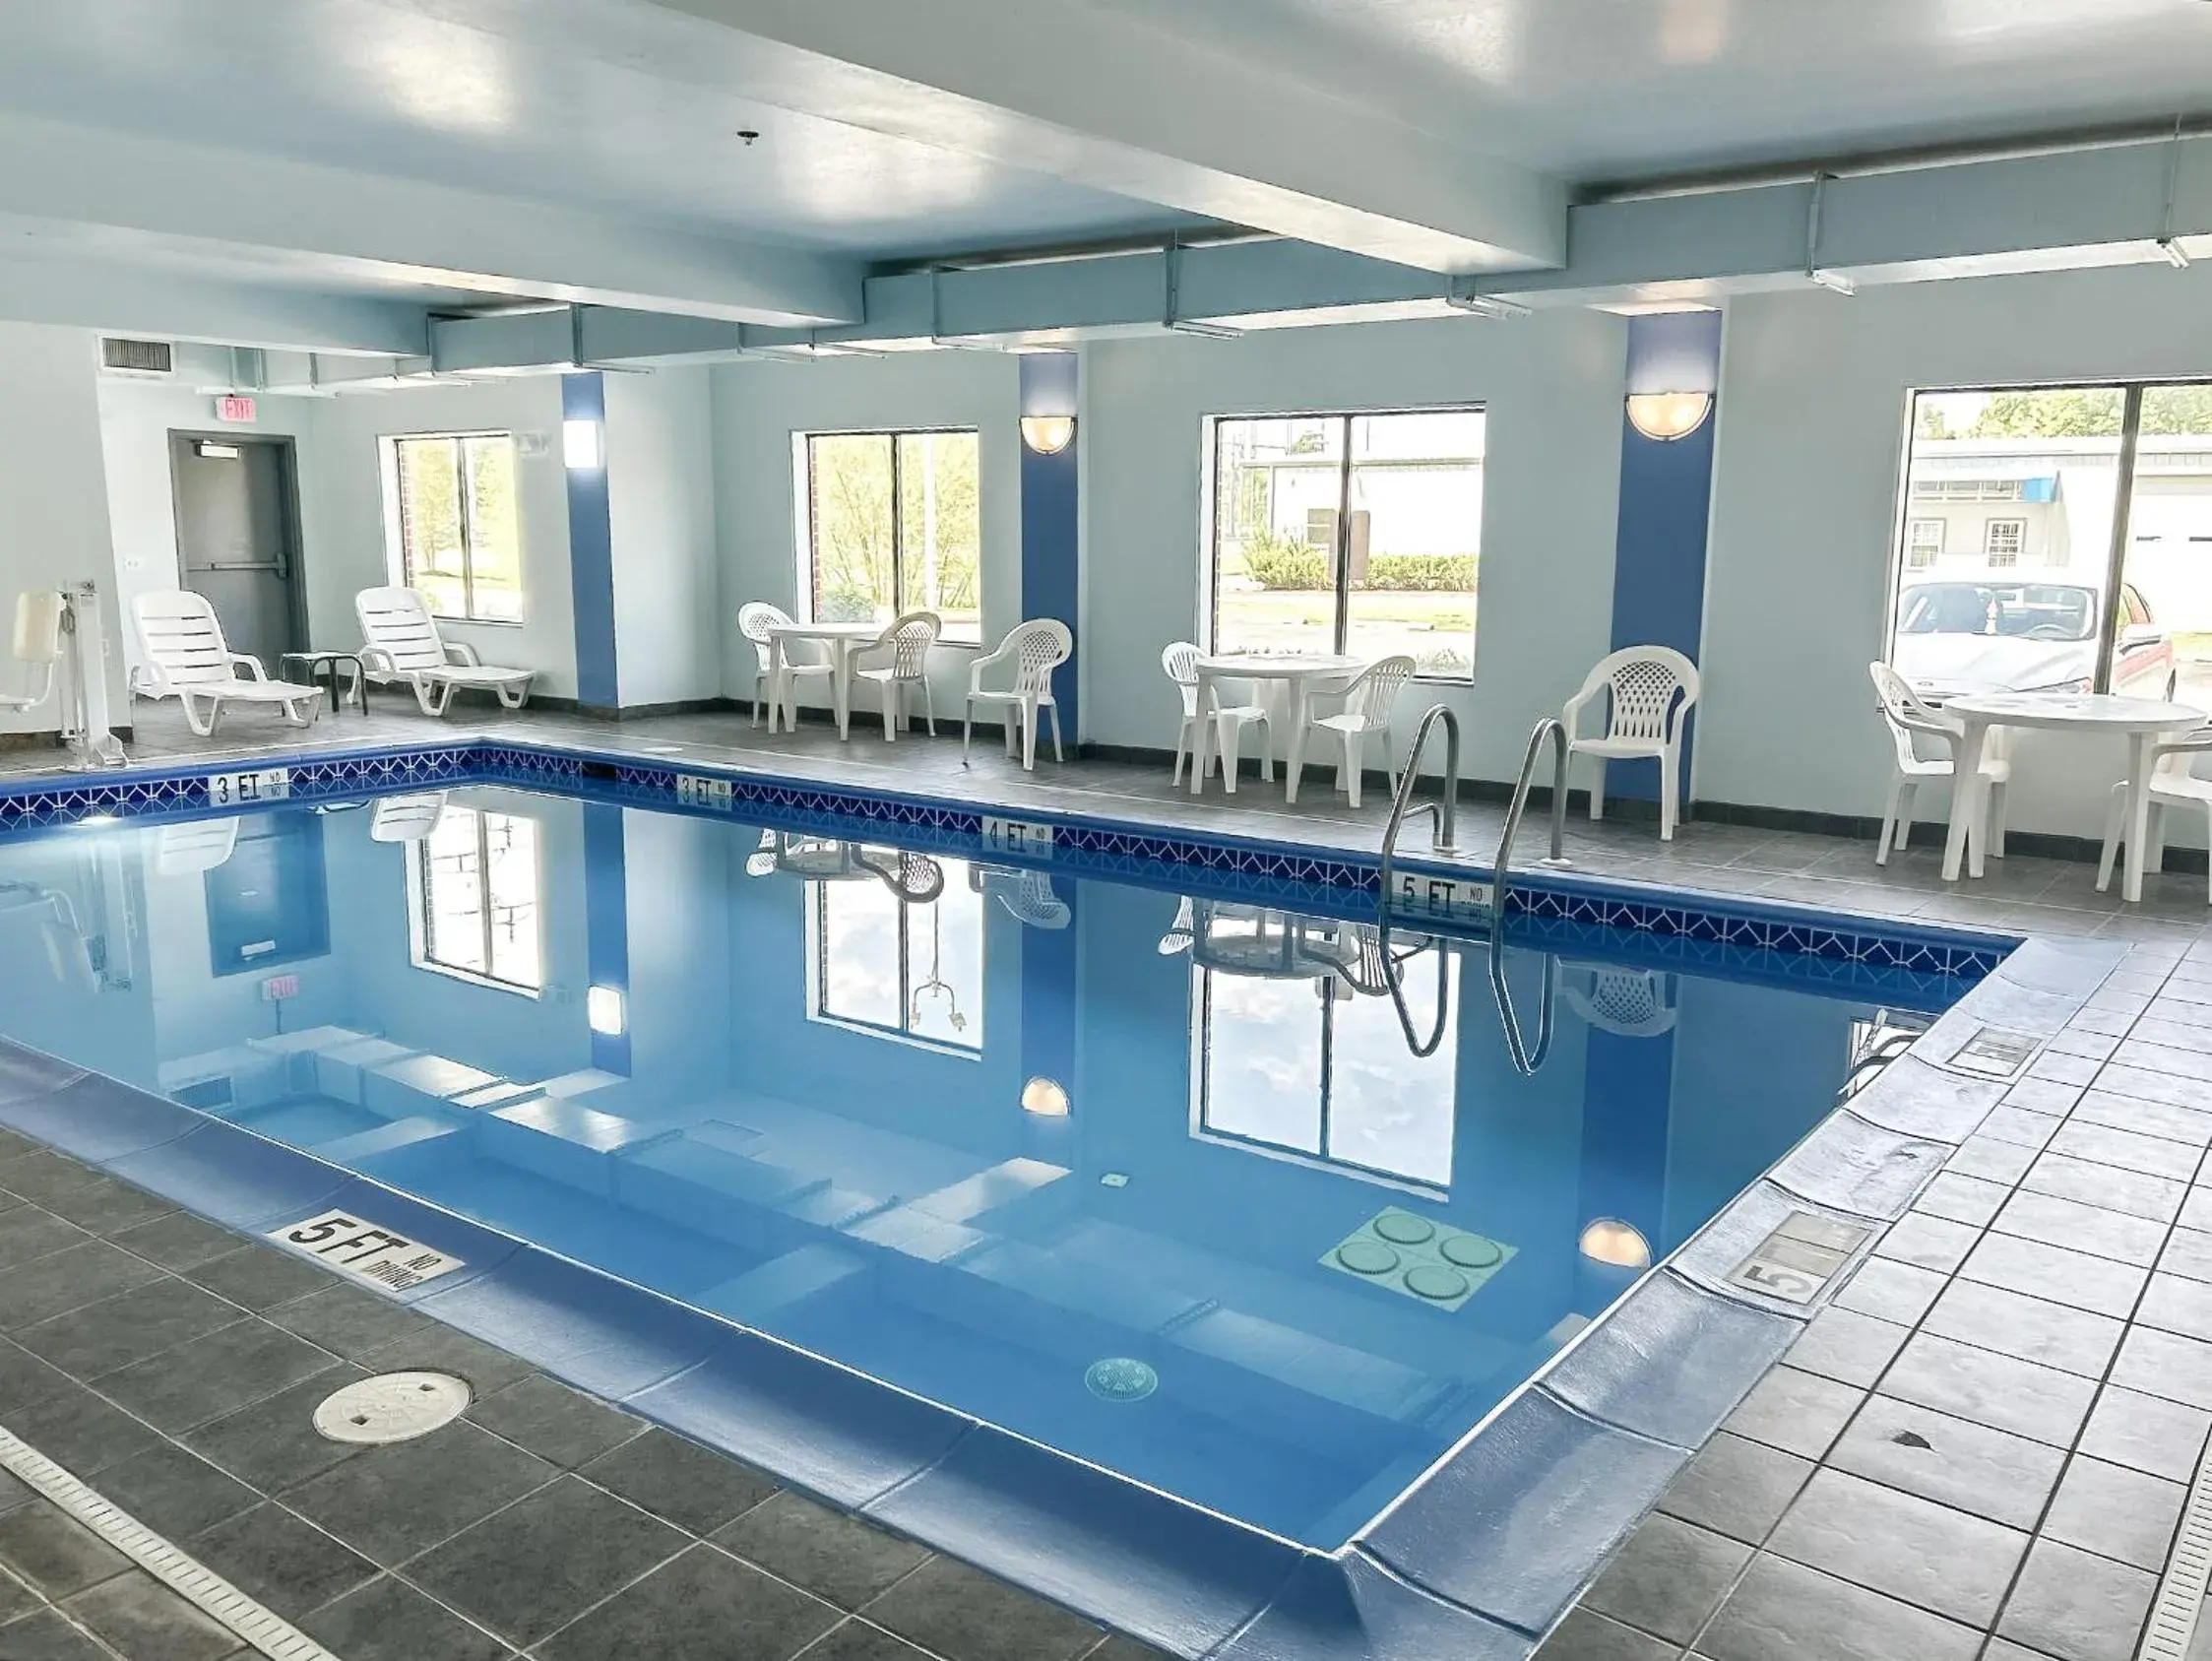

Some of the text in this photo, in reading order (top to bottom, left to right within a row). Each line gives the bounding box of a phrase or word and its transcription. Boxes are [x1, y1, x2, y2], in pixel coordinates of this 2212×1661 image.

[224, 398, 253, 419] EXIT
[288, 1218, 411, 1264] 5 FT
[404, 1252, 442, 1271] NO
[1743, 1265, 1812, 1294] 5
